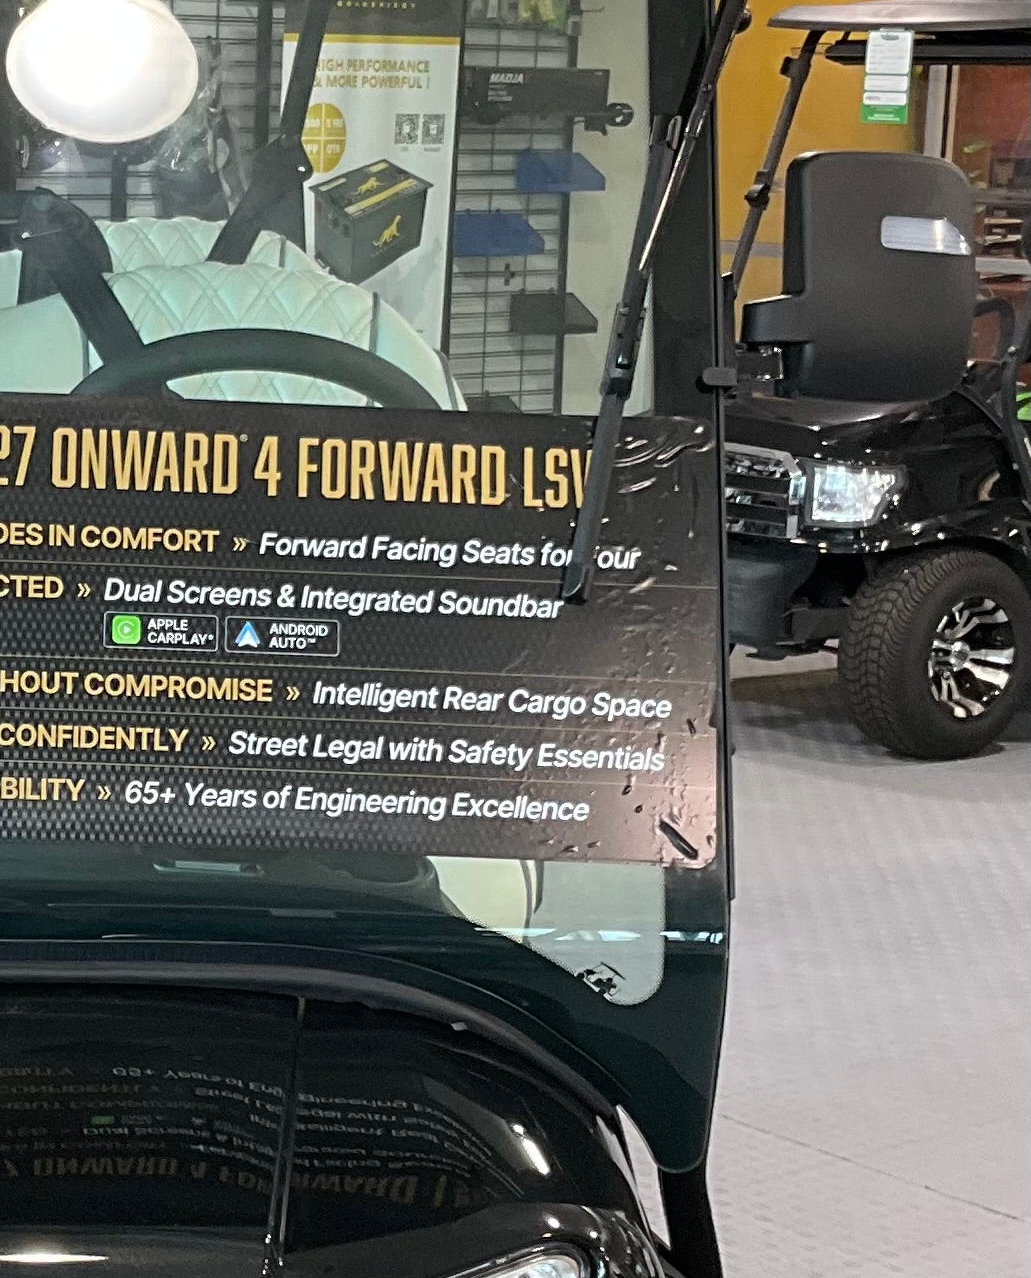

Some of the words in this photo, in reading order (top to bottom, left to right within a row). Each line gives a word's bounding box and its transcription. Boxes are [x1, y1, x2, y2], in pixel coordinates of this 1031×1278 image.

[327, 78, 357, 88] MORE
[362, 76, 422, 89] POWERFUL
[347, 59, 429, 73] PERFORMANCE
[253, 435, 282, 497] 4
[298, 437, 505, 506] FORWARD
[49, 524, 75, 547] IN
[80, 526, 219, 552] COMFORT
[259, 533, 367, 558] Forward
[372, 537, 456, 567] Facing
[463, 540, 535, 565] Seats
[594, 545, 641, 569] our
[105, 578, 161, 602] Dual
[167, 581, 272, 607] Screens
[277, 585, 295, 608] &
[301, 586, 432, 616] Integrated
[438, 591, 563, 619] Soundbar
[147, 619, 188, 631] APPLE
[269, 623, 328, 637] ANDROID
[84, 673, 273, 702] COMPROMISE
[313, 681, 437, 713] Intelligent
[443, 686, 503, 712] Rear
[508, 690, 587, 717] Cargo
[591, 693, 672, 721] Space
[229, 731, 308, 757] Street
[312, 734, 384, 765] Legal
[389, 737, 443, 762] with
[448, 739, 533, 771] Safety
[537, 744, 665, 771] Essentials
[125, 781, 175, 805] 65+
[185, 782, 257, 808] Years
[263, 786, 291, 809] of
[295, 787, 447, 821] Engineering
[452, 797, 589, 821] Excellence
